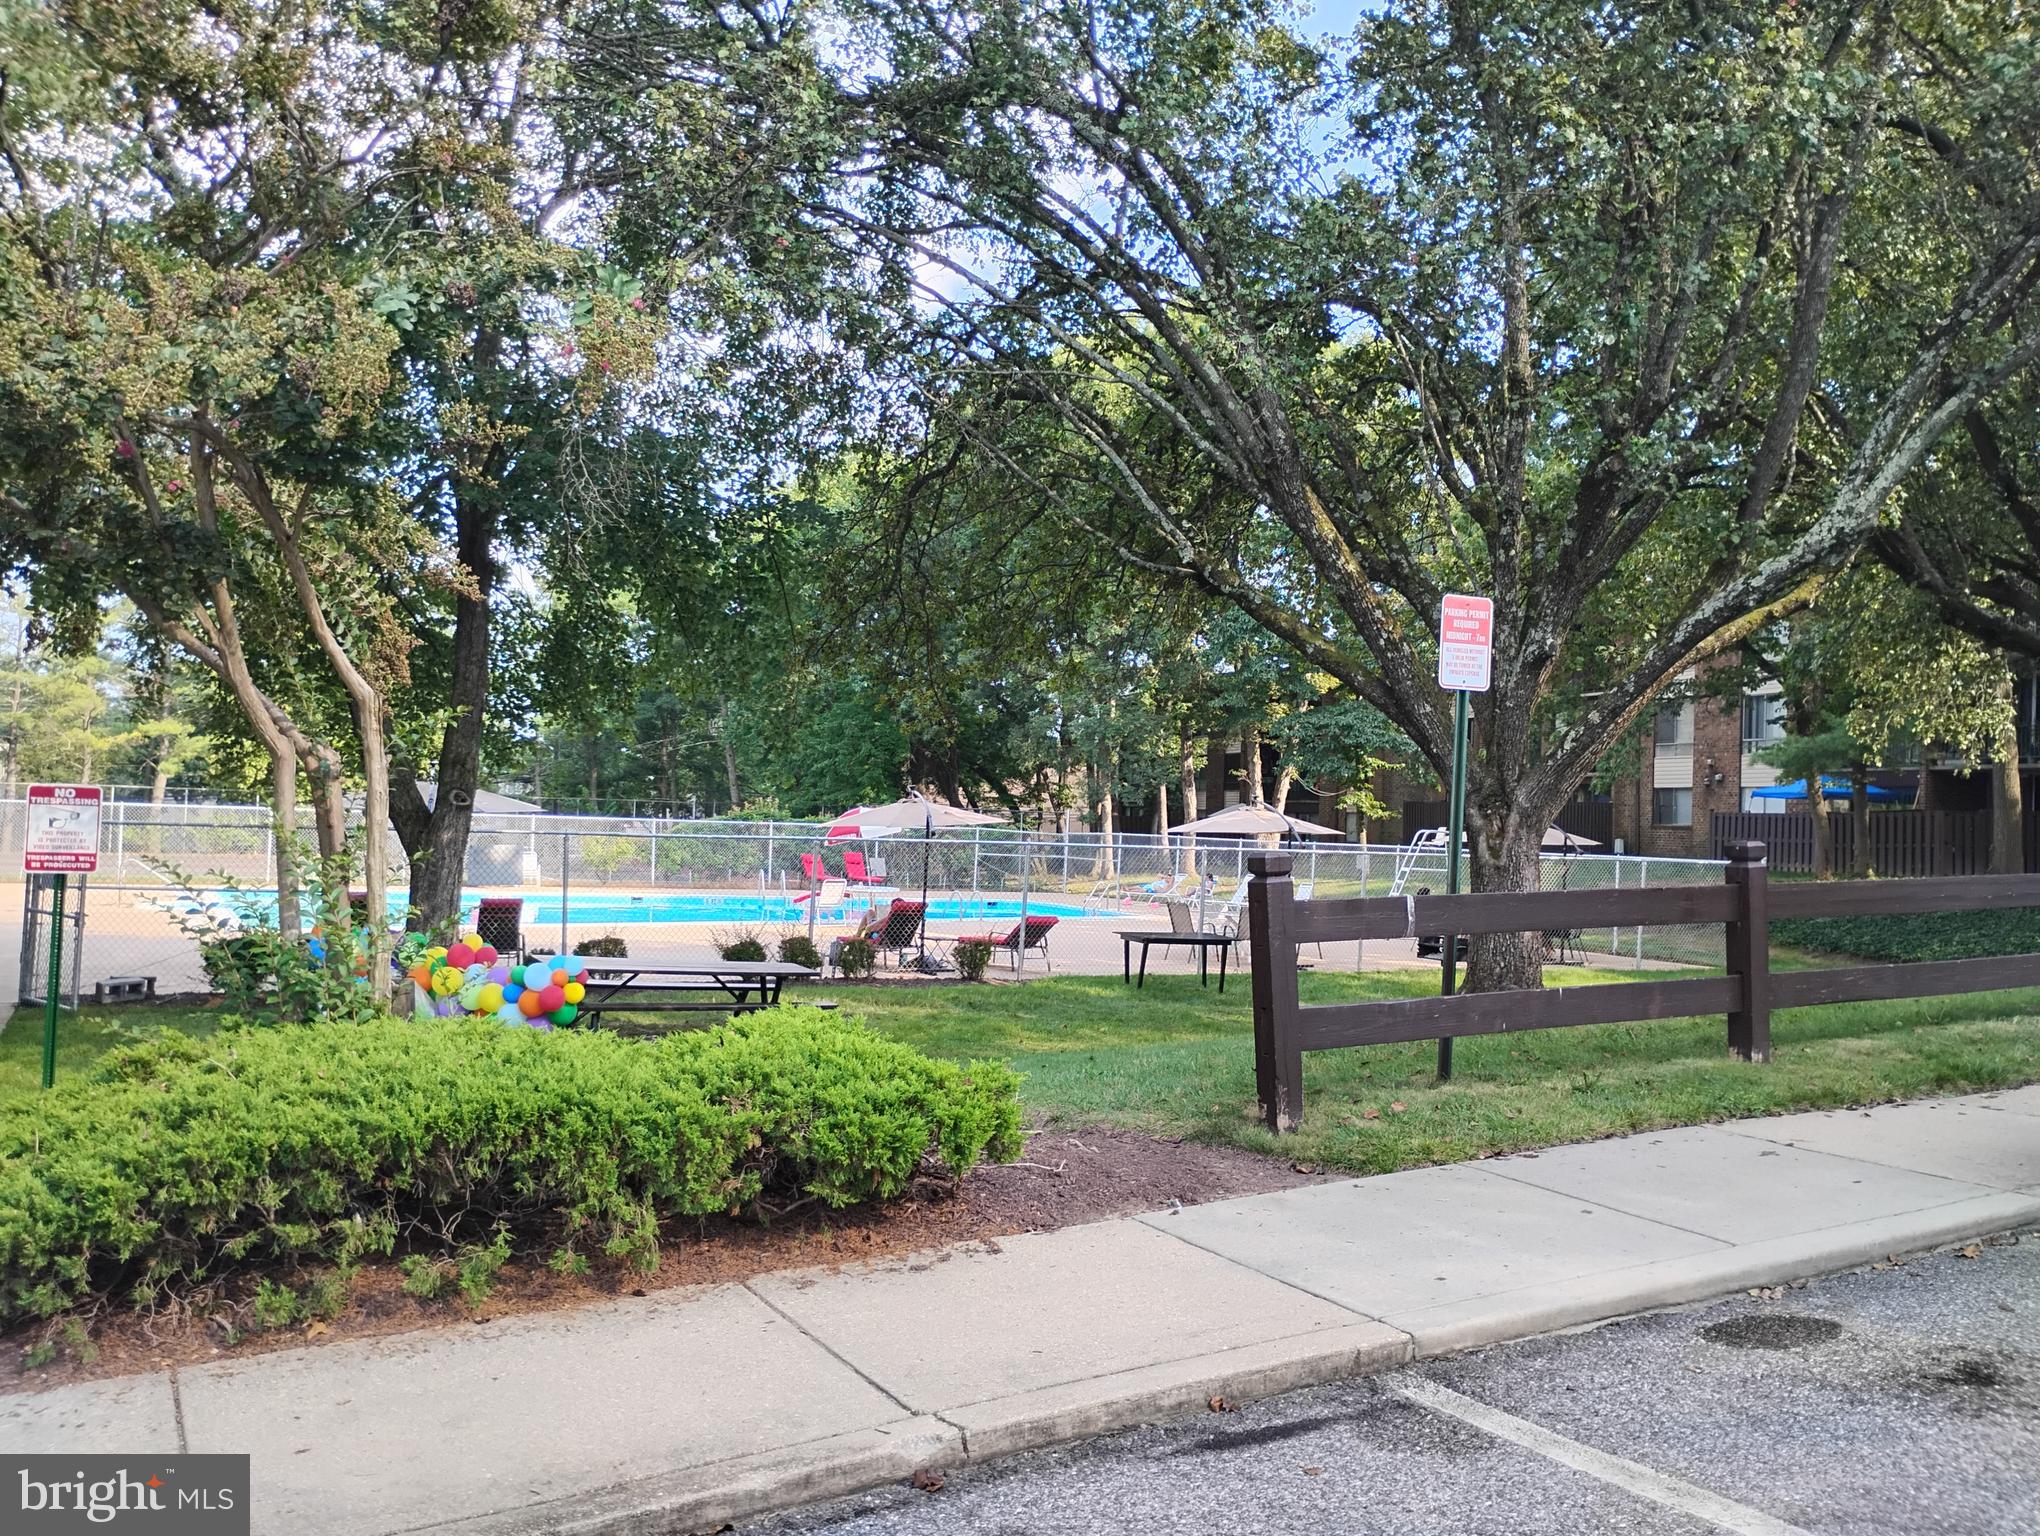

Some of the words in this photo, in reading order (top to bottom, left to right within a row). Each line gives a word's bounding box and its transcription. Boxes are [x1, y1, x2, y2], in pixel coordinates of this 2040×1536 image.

[1469, 609, 1489, 619] PERMIT
[1453, 619, 1480, 629] REQUIRED
[1446, 630, 1472, 641] MIDNIGHT
[54, 787, 76, 798] NO
[31, 797, 99, 805] TRESPASSING
